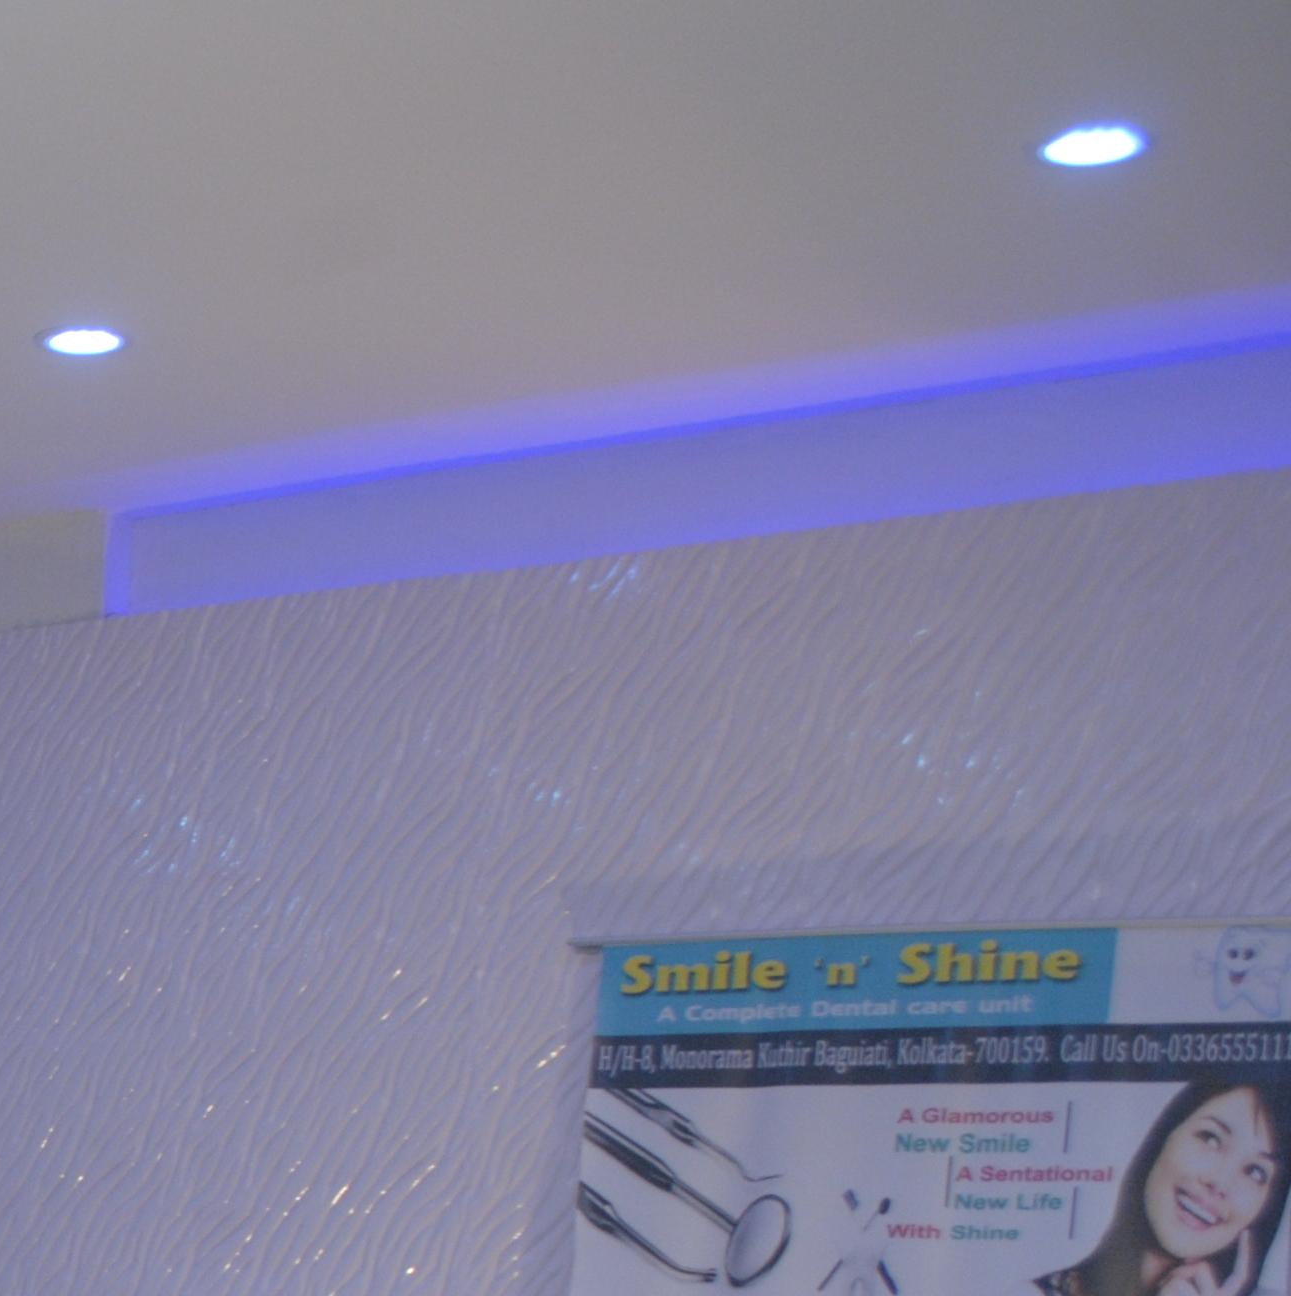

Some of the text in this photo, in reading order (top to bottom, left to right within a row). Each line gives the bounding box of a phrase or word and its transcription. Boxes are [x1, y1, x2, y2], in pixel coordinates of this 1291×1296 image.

[621, 950, 789, 995] Smile
[897, 940, 1083, 986] Shine
[658, 995, 1034, 1023] A Complete Dental care unit
[660, 1042, 753, 1070] Monorama
[757, 1039, 810, 1068] Kuthir
[815, 1038, 892, 1073] Baguiati,
[1059, 1033, 1097, 1062] Call
[1103, 1034, 1125, 1062] Us
[897, 1108, 1054, 1123] A Glamorous
[895, 1133, 1031, 1153] New Smile
[955, 1166, 1113, 1182] A Sentational
[954, 1193, 1062, 1210] New Life
[887, 1224, 1019, 1240] With Shine
